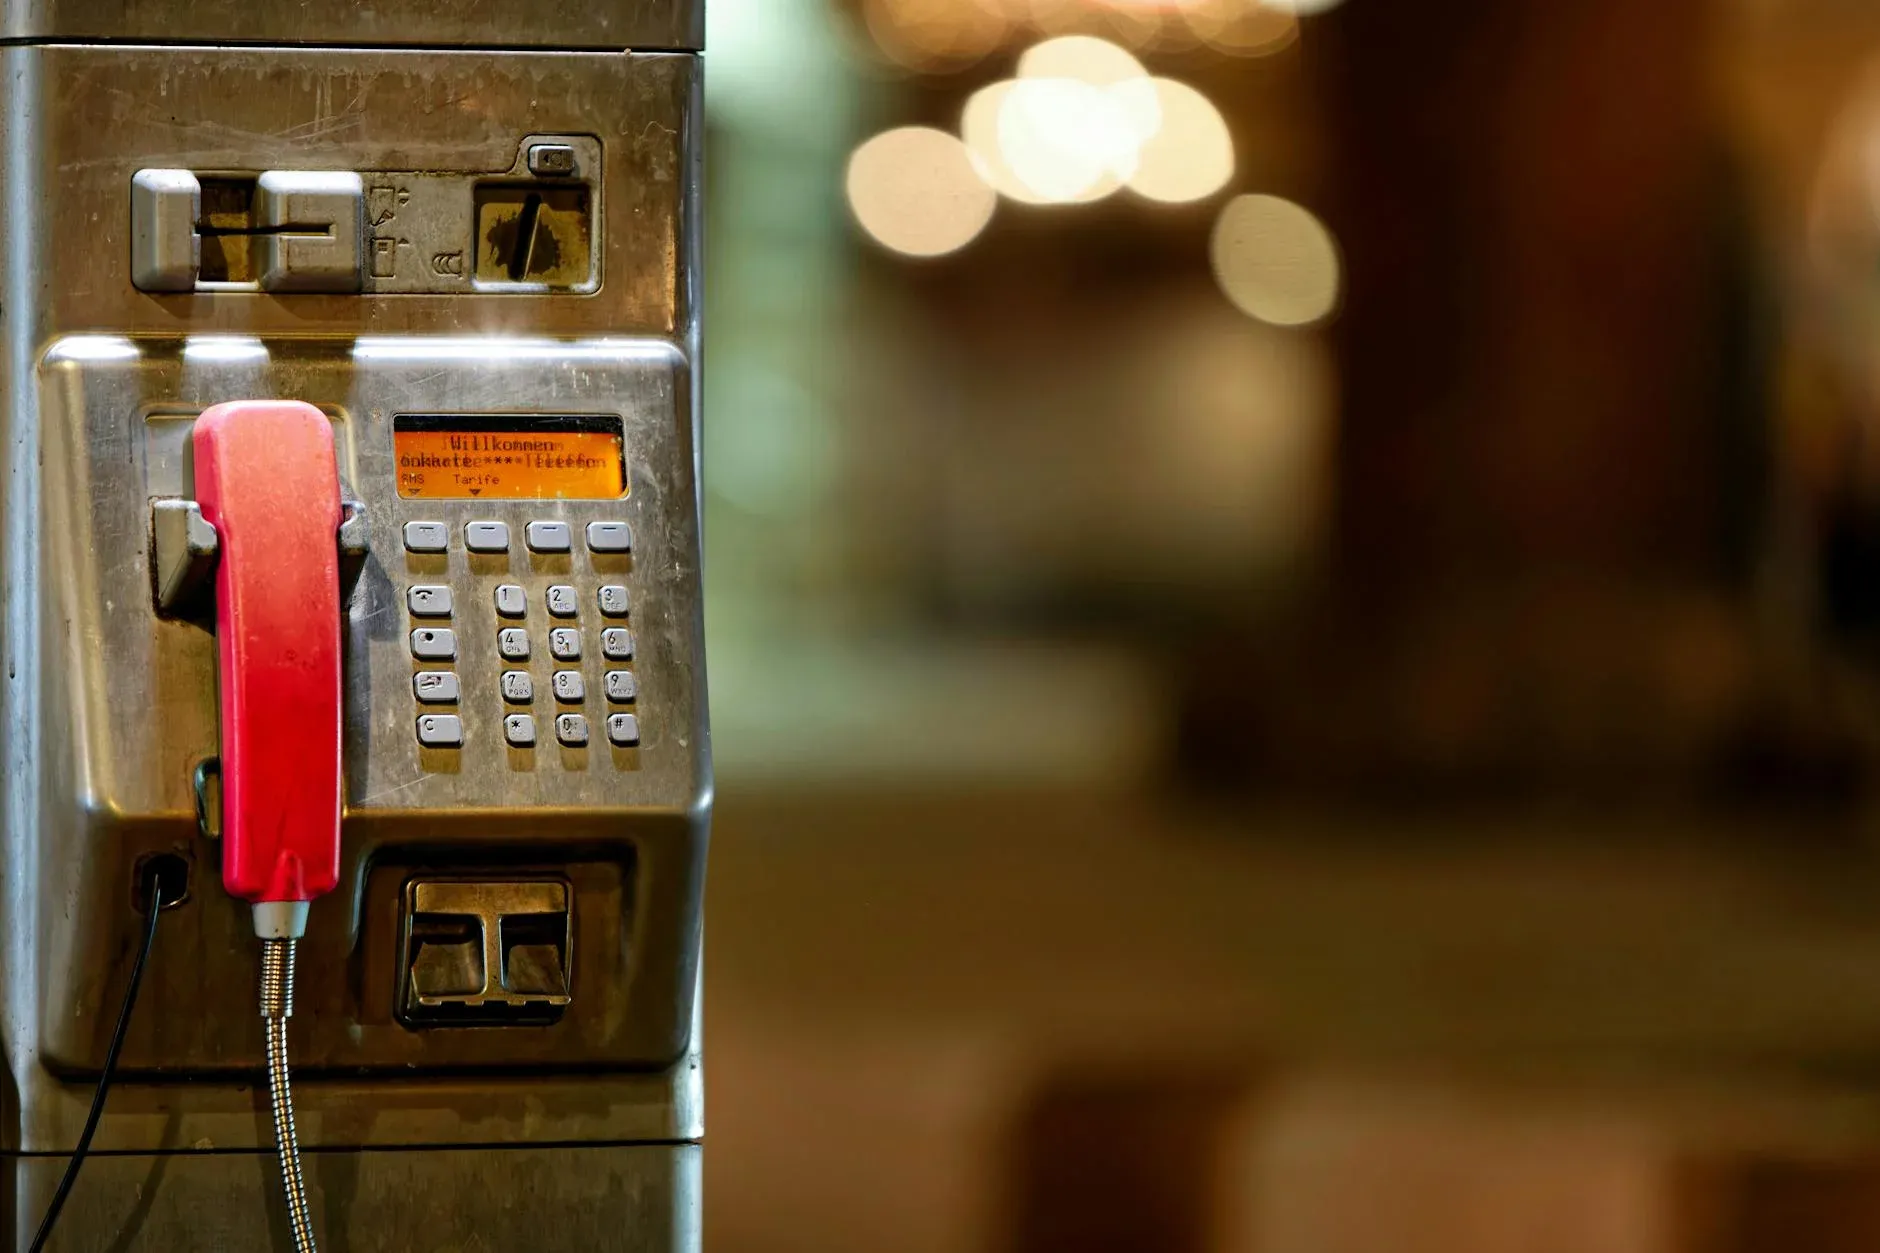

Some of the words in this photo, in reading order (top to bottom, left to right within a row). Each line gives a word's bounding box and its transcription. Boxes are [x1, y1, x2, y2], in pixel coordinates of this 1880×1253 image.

[450, 435, 555, 451] Willkommen
[452, 473, 500, 485] Tarife
[503, 588, 507, 601] 1
[553, 588, 561, 601] 2
[605, 588, 613, 601] 3
[505, 632, 514, 643] 4
[557, 632, 565, 645] 5
[608, 632, 616, 645] 6
[508, 674, 516, 687] 7
[560, 674, 568, 687] 8
[611, 674, 619, 687] 9
[424, 718, 434, 731] C
